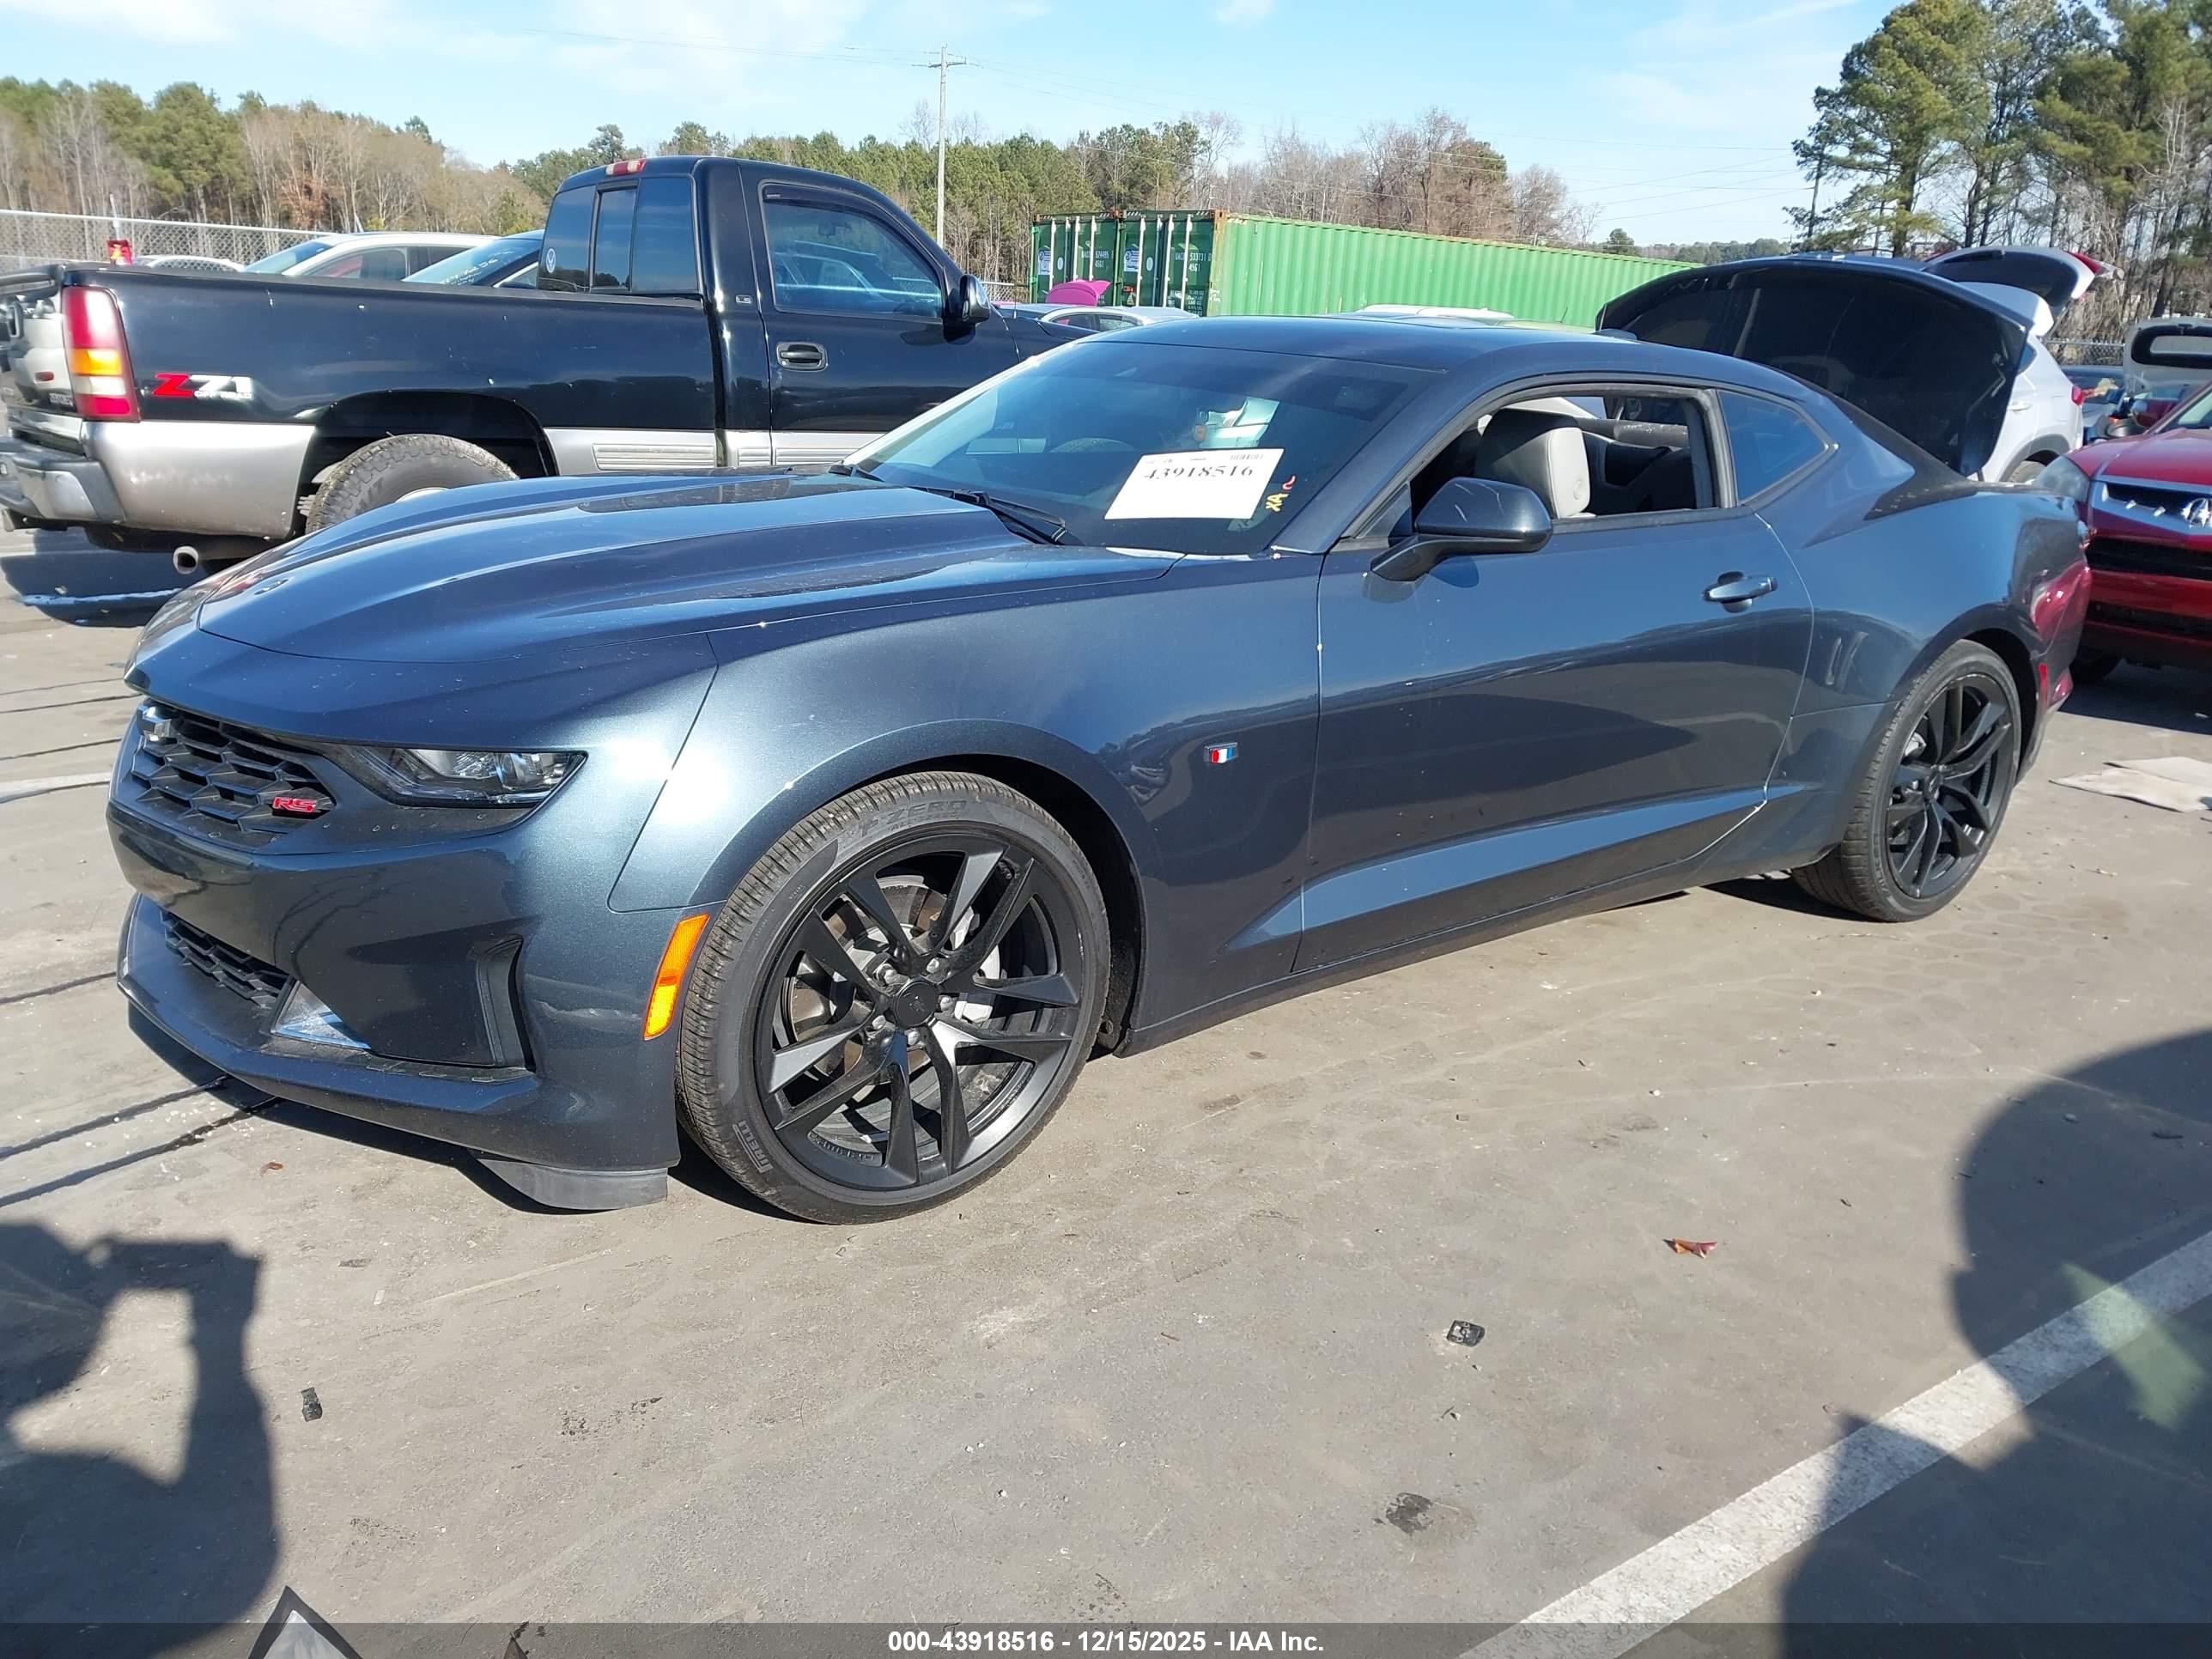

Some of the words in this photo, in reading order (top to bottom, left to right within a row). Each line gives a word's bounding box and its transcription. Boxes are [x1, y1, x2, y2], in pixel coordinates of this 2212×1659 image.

[152, 372, 252, 398] Z71
[1143, 465, 1254, 480] 43918516
[272, 797, 316, 812] RS
